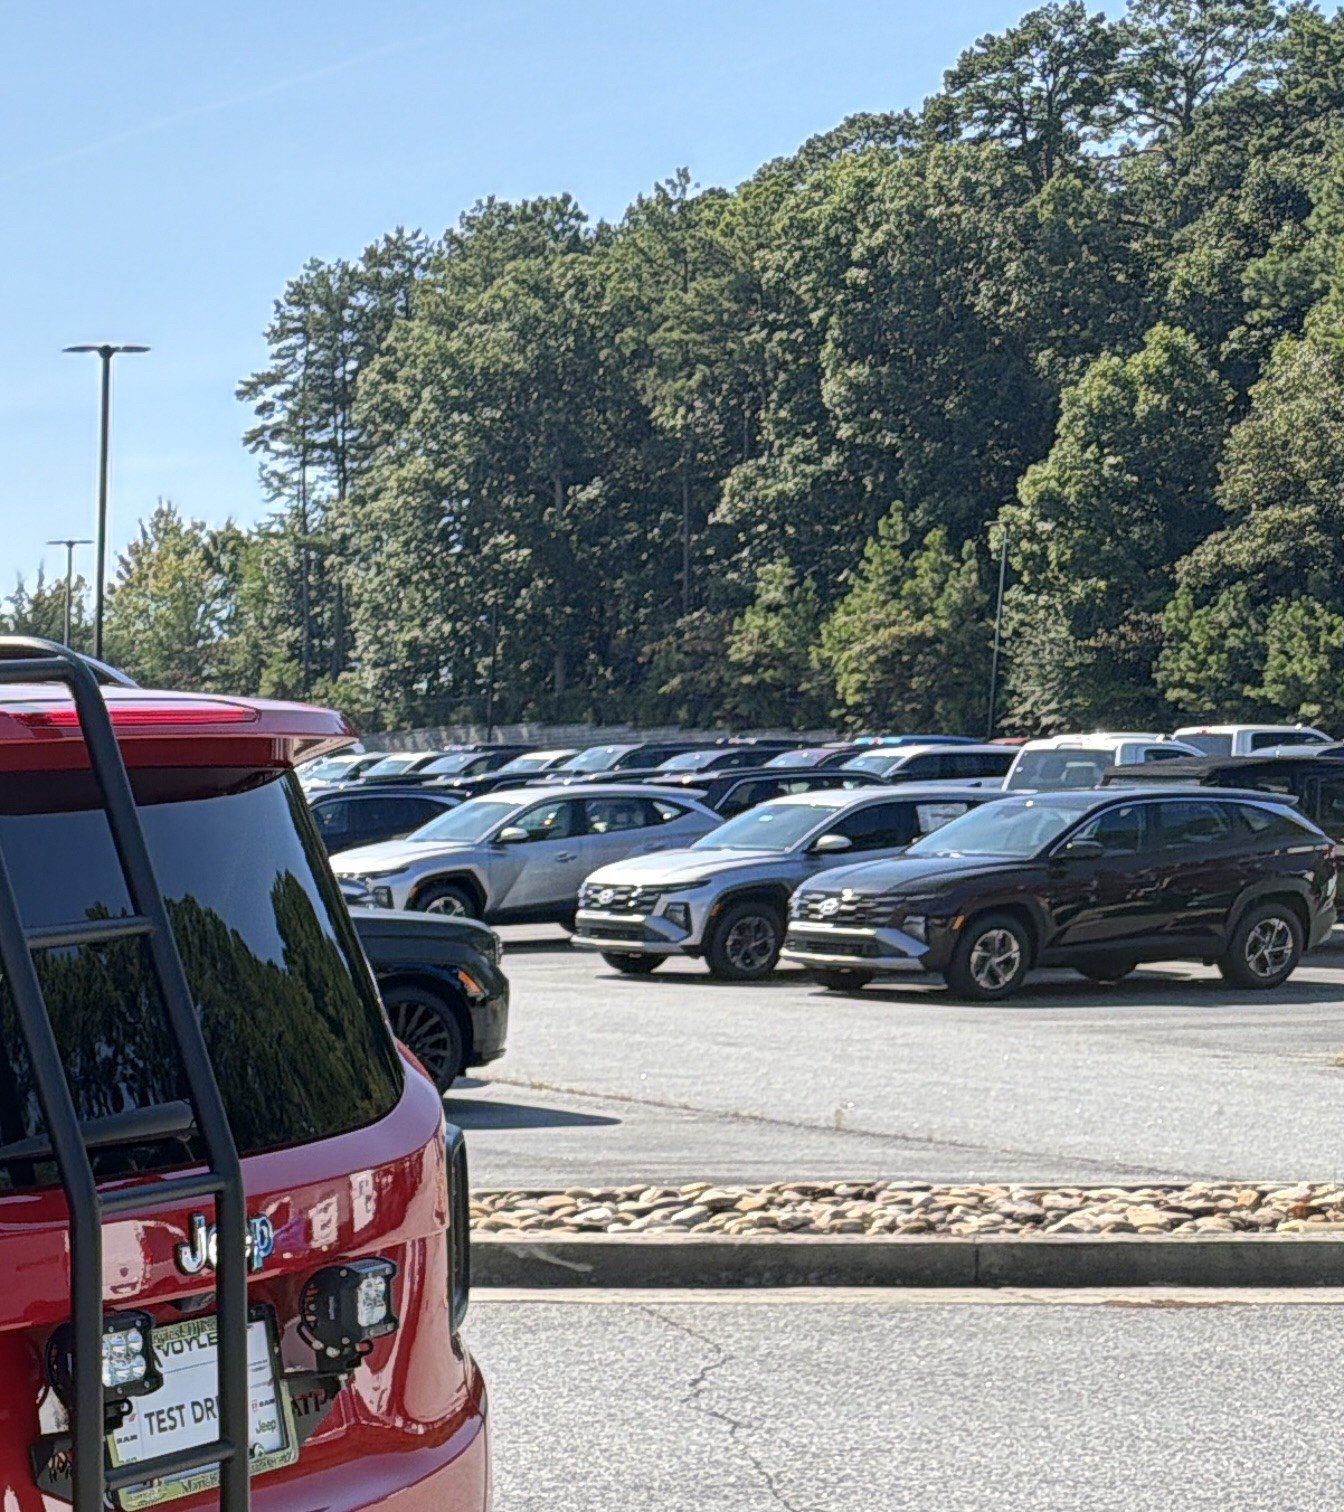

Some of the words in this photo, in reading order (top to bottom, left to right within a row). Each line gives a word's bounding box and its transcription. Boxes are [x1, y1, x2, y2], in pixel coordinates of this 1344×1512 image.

[175, 1213, 274, 1275] Jp
[155, 1330, 218, 1357] VOYLE
[144, 1404, 185, 1436] TEST
[190, 1396, 220, 1424] DR
